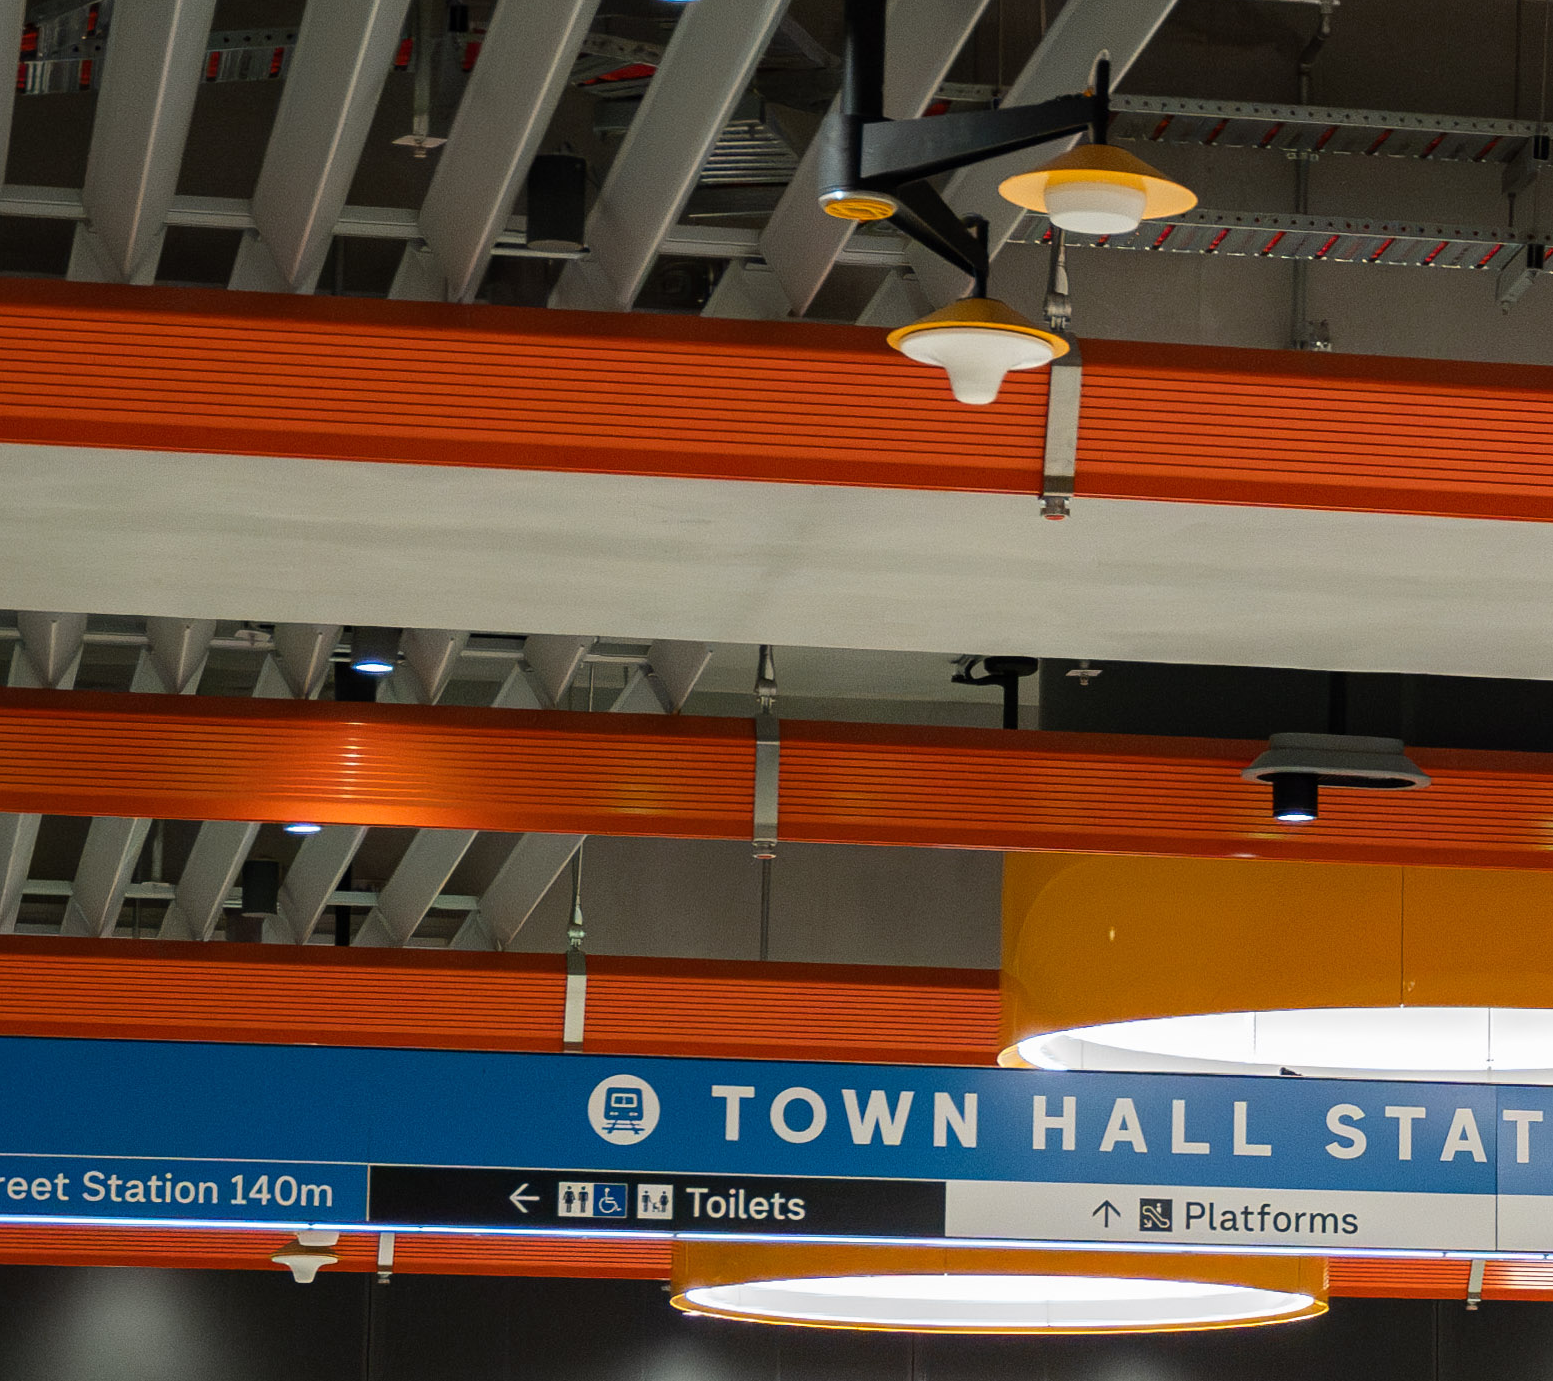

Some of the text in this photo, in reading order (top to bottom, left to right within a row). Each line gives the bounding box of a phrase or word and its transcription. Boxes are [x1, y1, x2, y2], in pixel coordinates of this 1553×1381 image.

[711, 1084, 978, 1149] TOWN
[1032, 1095, 1272, 1157] HALL
[82, 1170, 219, 1205] Station
[230, 1174, 334, 1208] 140m
[685, 1187, 806, 1222] Toilets
[1185, 1201, 1359, 1236] Platforms
